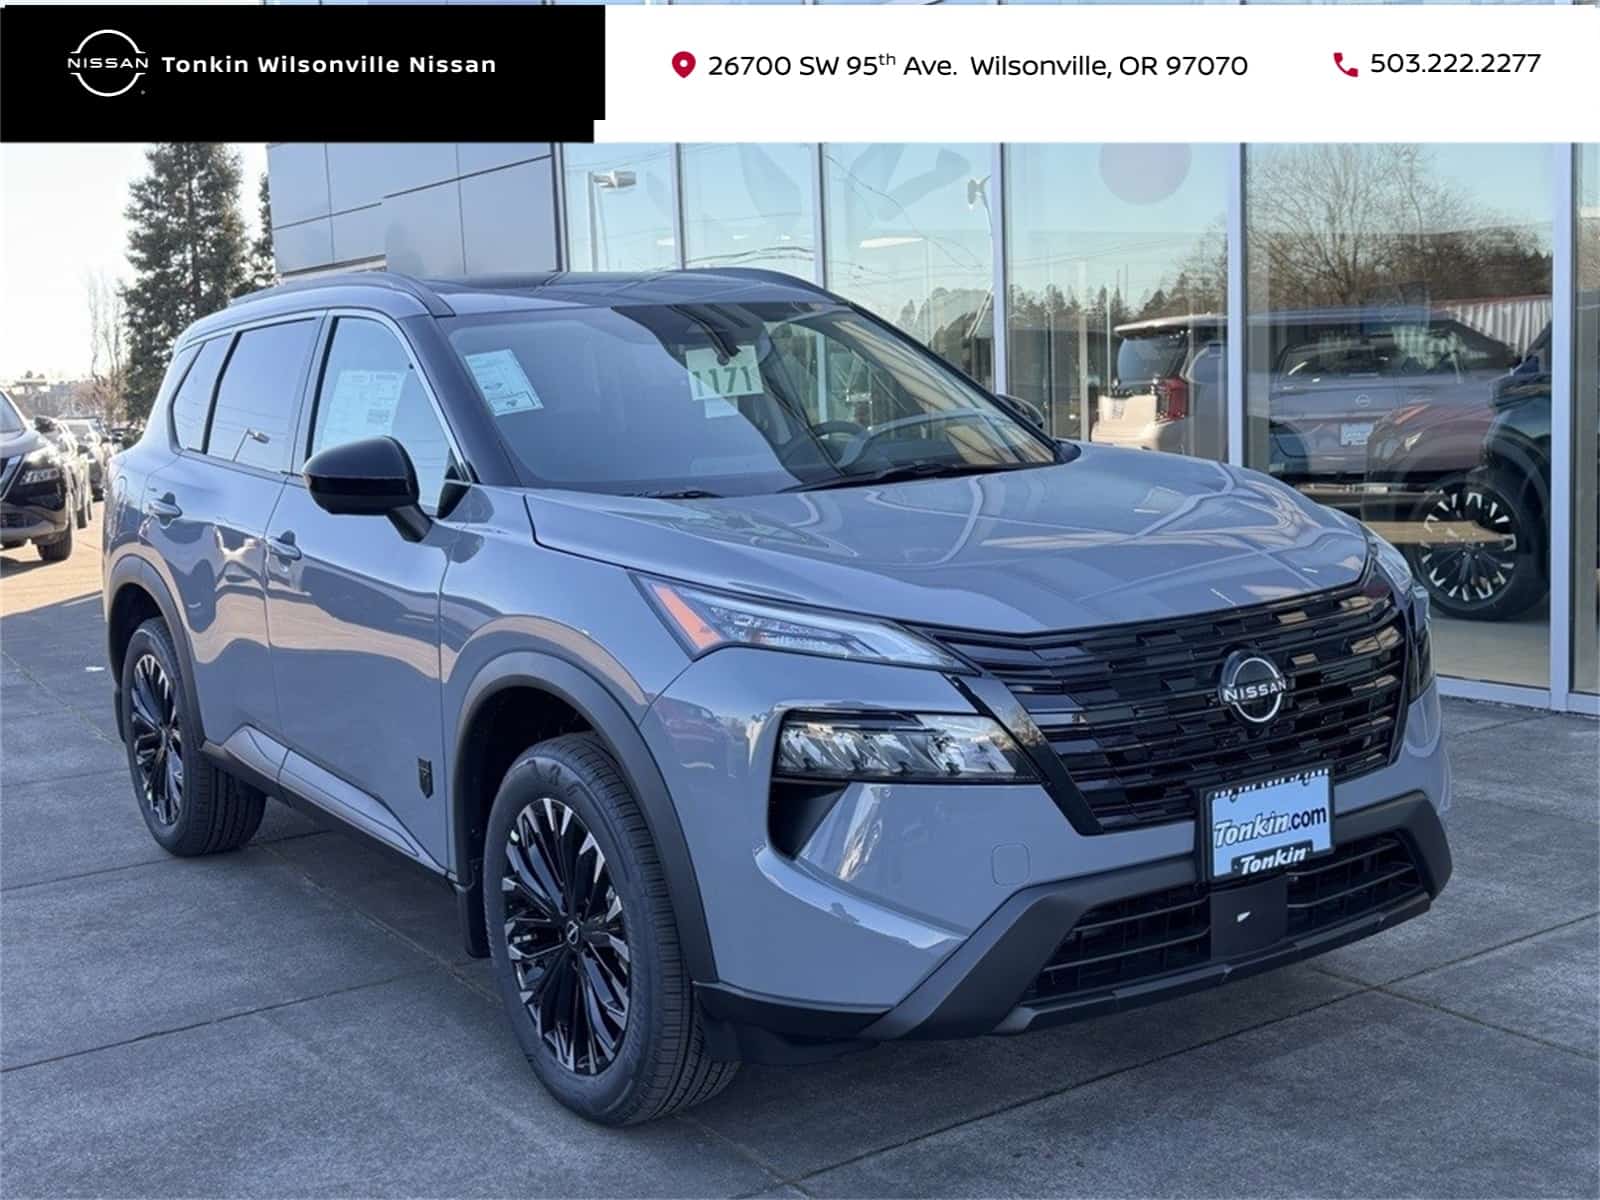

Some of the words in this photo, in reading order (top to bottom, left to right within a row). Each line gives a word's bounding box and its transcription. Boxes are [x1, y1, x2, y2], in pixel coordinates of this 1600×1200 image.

[692, 366, 752, 397] 1171
[1223, 678, 1287, 702] NISSAN
[1214, 806, 1328, 849] Tonkin.com
[1240, 846, 1306, 875] Tonkin
